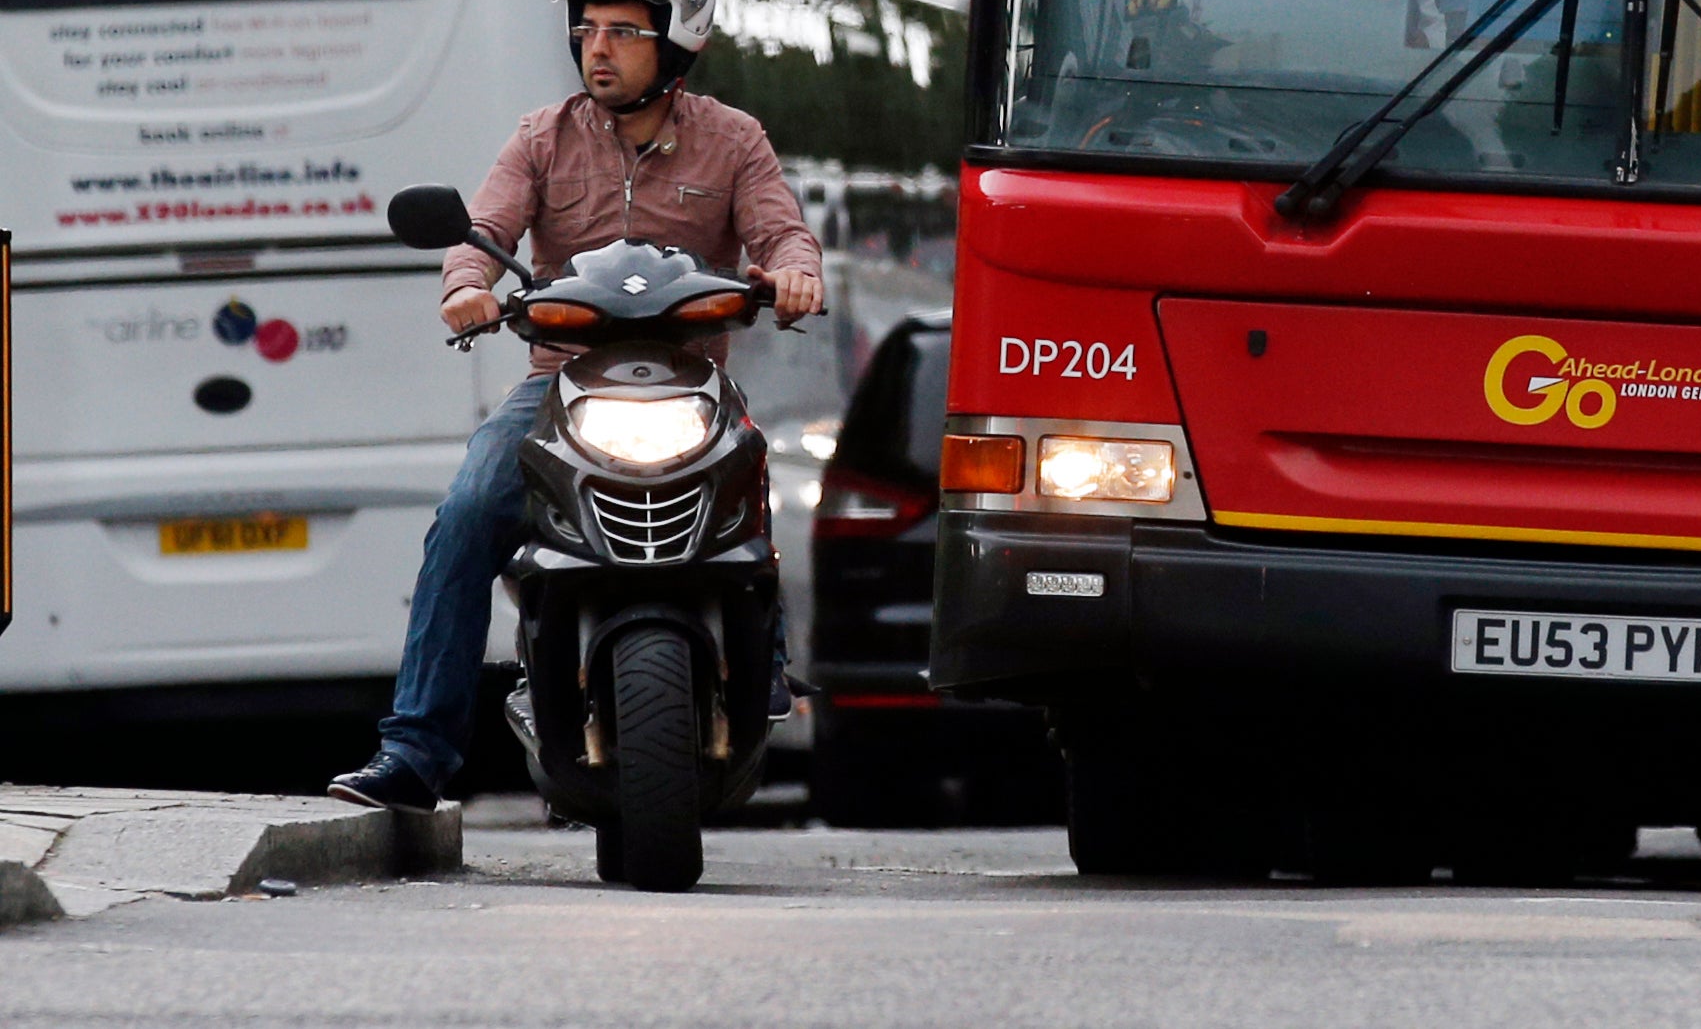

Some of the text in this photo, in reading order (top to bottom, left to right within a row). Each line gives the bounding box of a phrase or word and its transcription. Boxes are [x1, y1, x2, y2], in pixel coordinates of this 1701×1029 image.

[139, 122, 191, 144] book
[199, 121, 265, 140] online
[71, 157, 361, 193] www.theairline.info
[999, 336, 1138, 381] DP204
[1484, 334, 1617, 430] Go
[1620, 383, 1678, 399] LONDON
[1475, 618, 1608, 669] EU53
